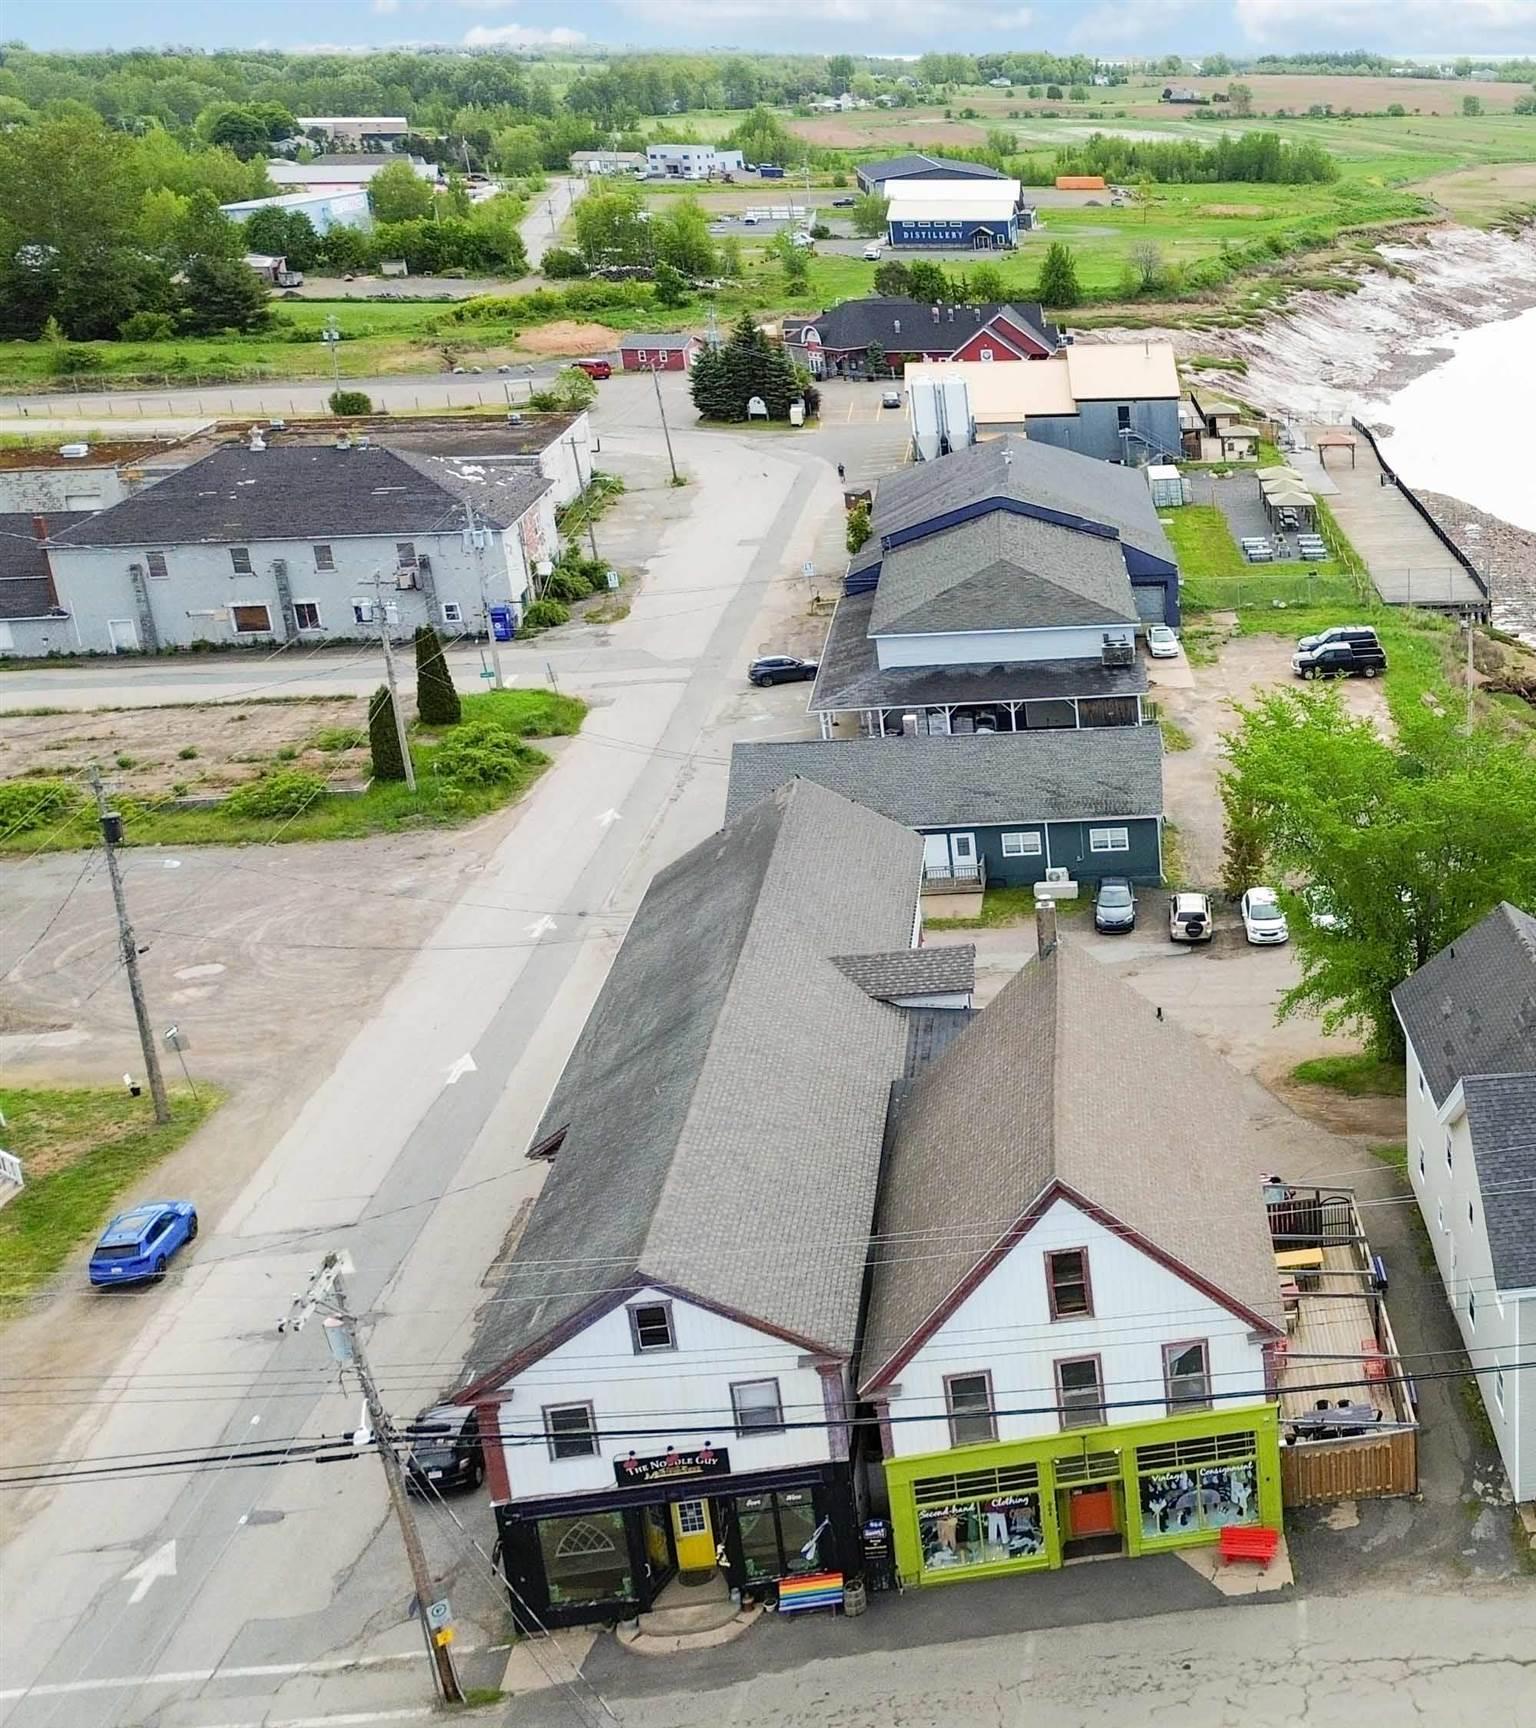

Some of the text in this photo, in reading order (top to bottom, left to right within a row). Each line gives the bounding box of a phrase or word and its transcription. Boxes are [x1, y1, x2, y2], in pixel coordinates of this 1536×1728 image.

[903, 231, 963, 239] DISTILLERY
[650, 1457, 693, 1470] NODLE
[1200, 1461, 1254, 1476] Consignment
[991, 1496, 1029, 1507] Clothing
[919, 1503, 976, 1519] Second-hand
